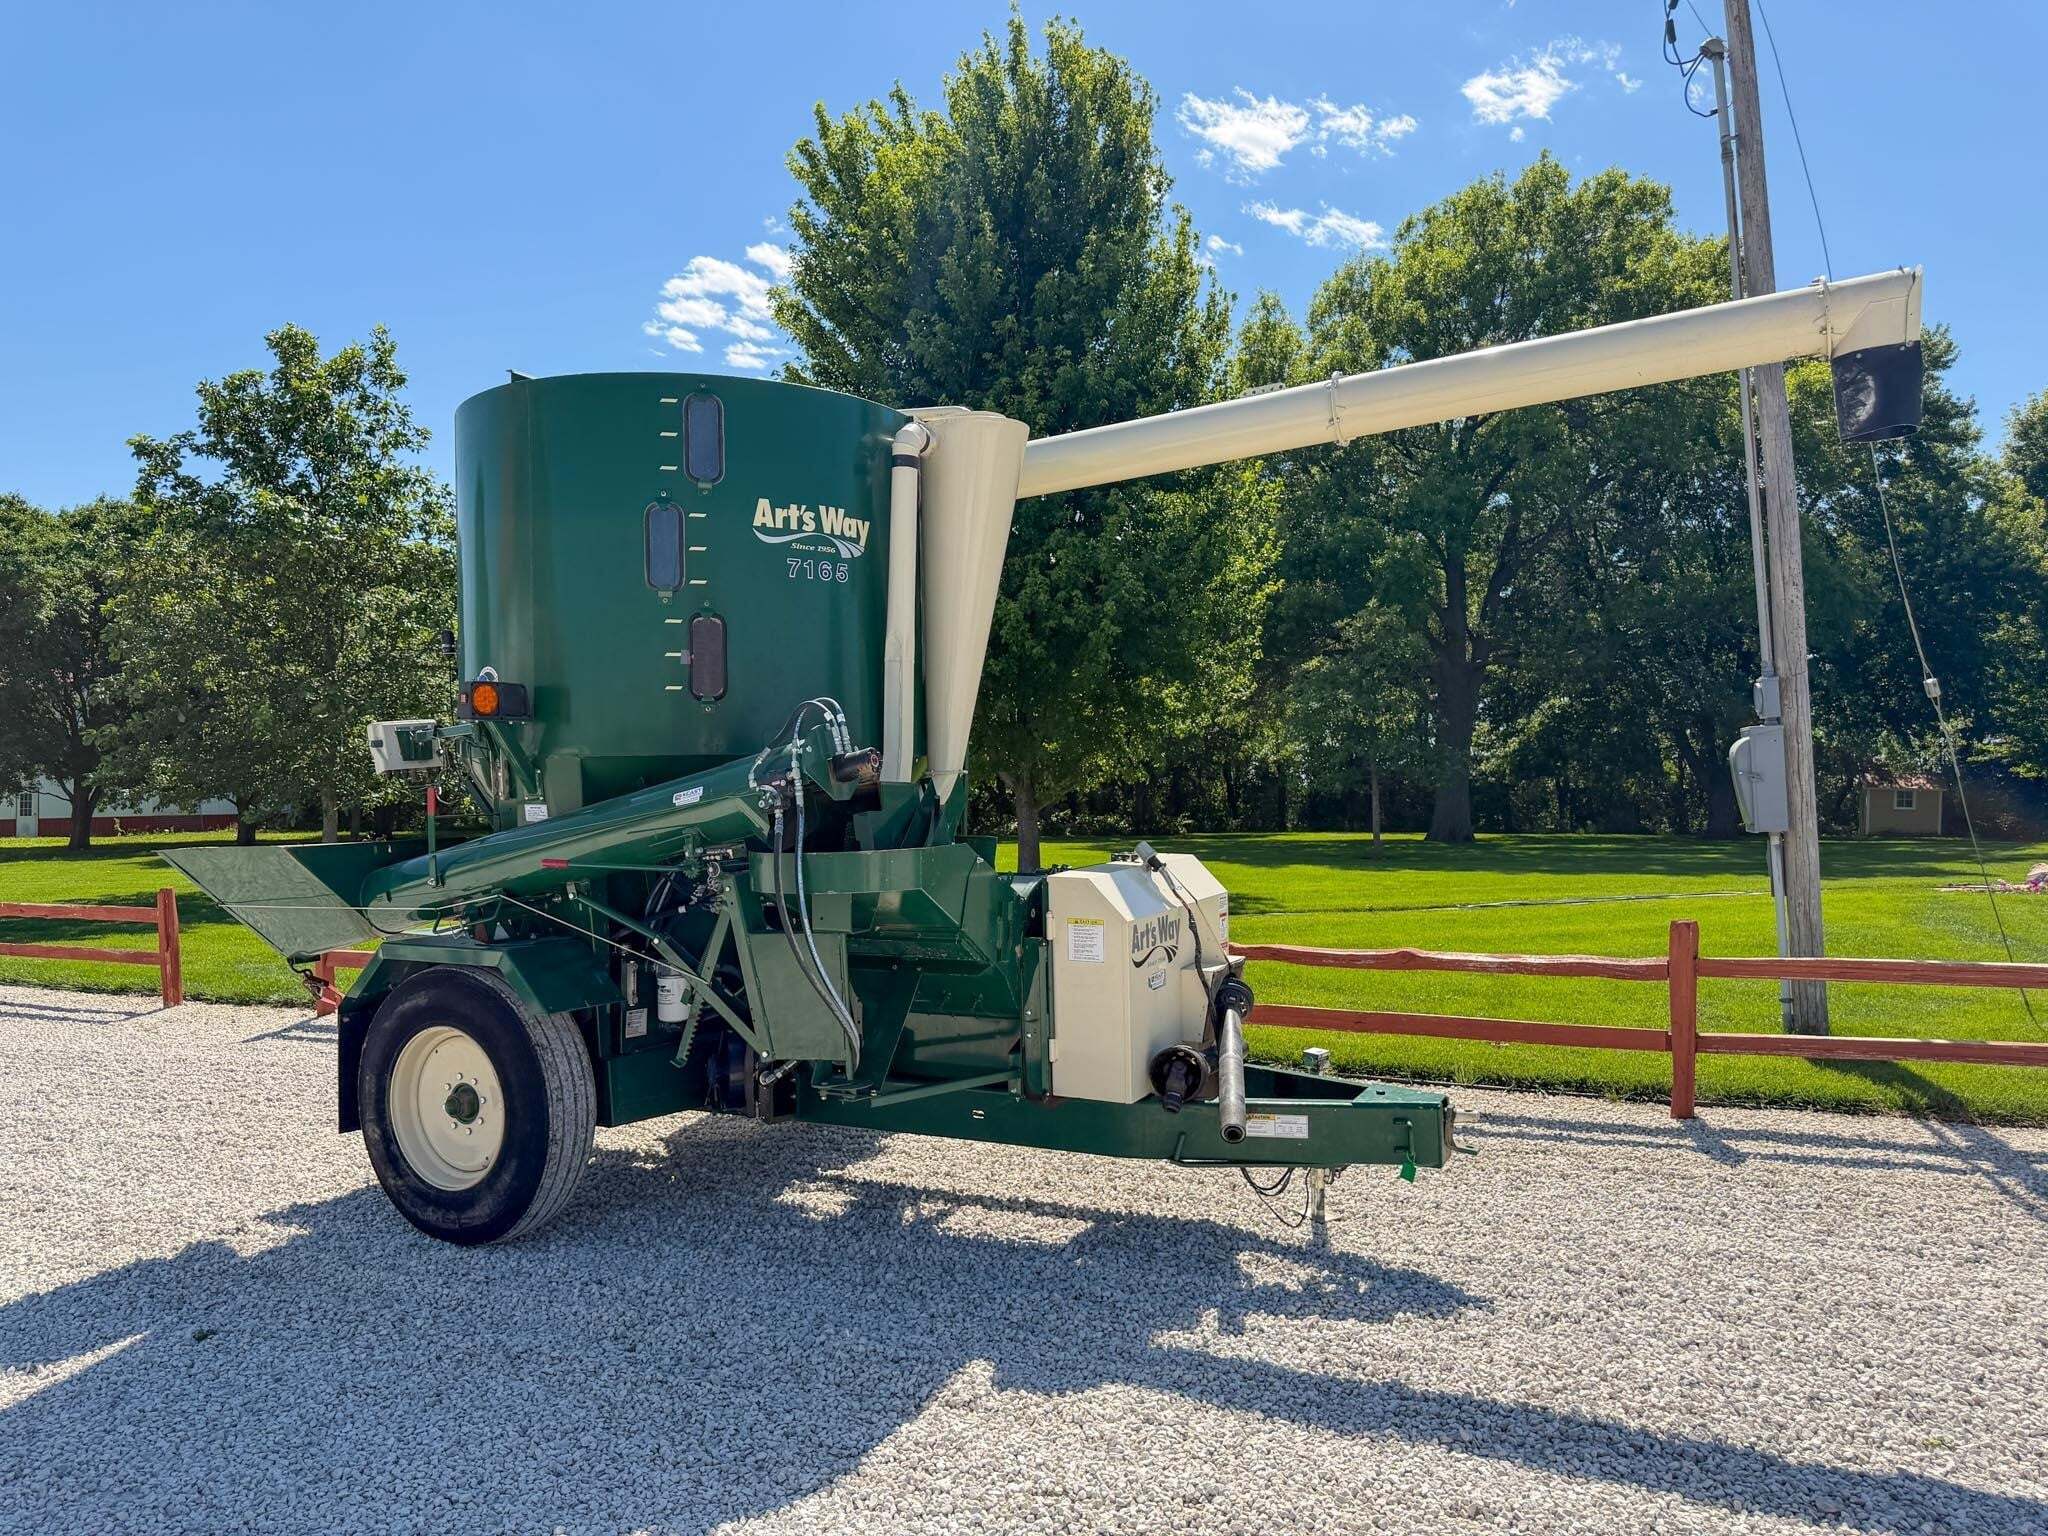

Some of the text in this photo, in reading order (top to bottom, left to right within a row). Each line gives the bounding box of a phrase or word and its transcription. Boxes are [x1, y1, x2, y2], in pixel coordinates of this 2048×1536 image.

[752, 498, 870, 549] Art's Way
[791, 542, 836, 553] Since 1956
[786, 558, 849, 583] 7165
[1132, 921, 1156, 954] Art's
[1157, 915, 1180, 946] Way
